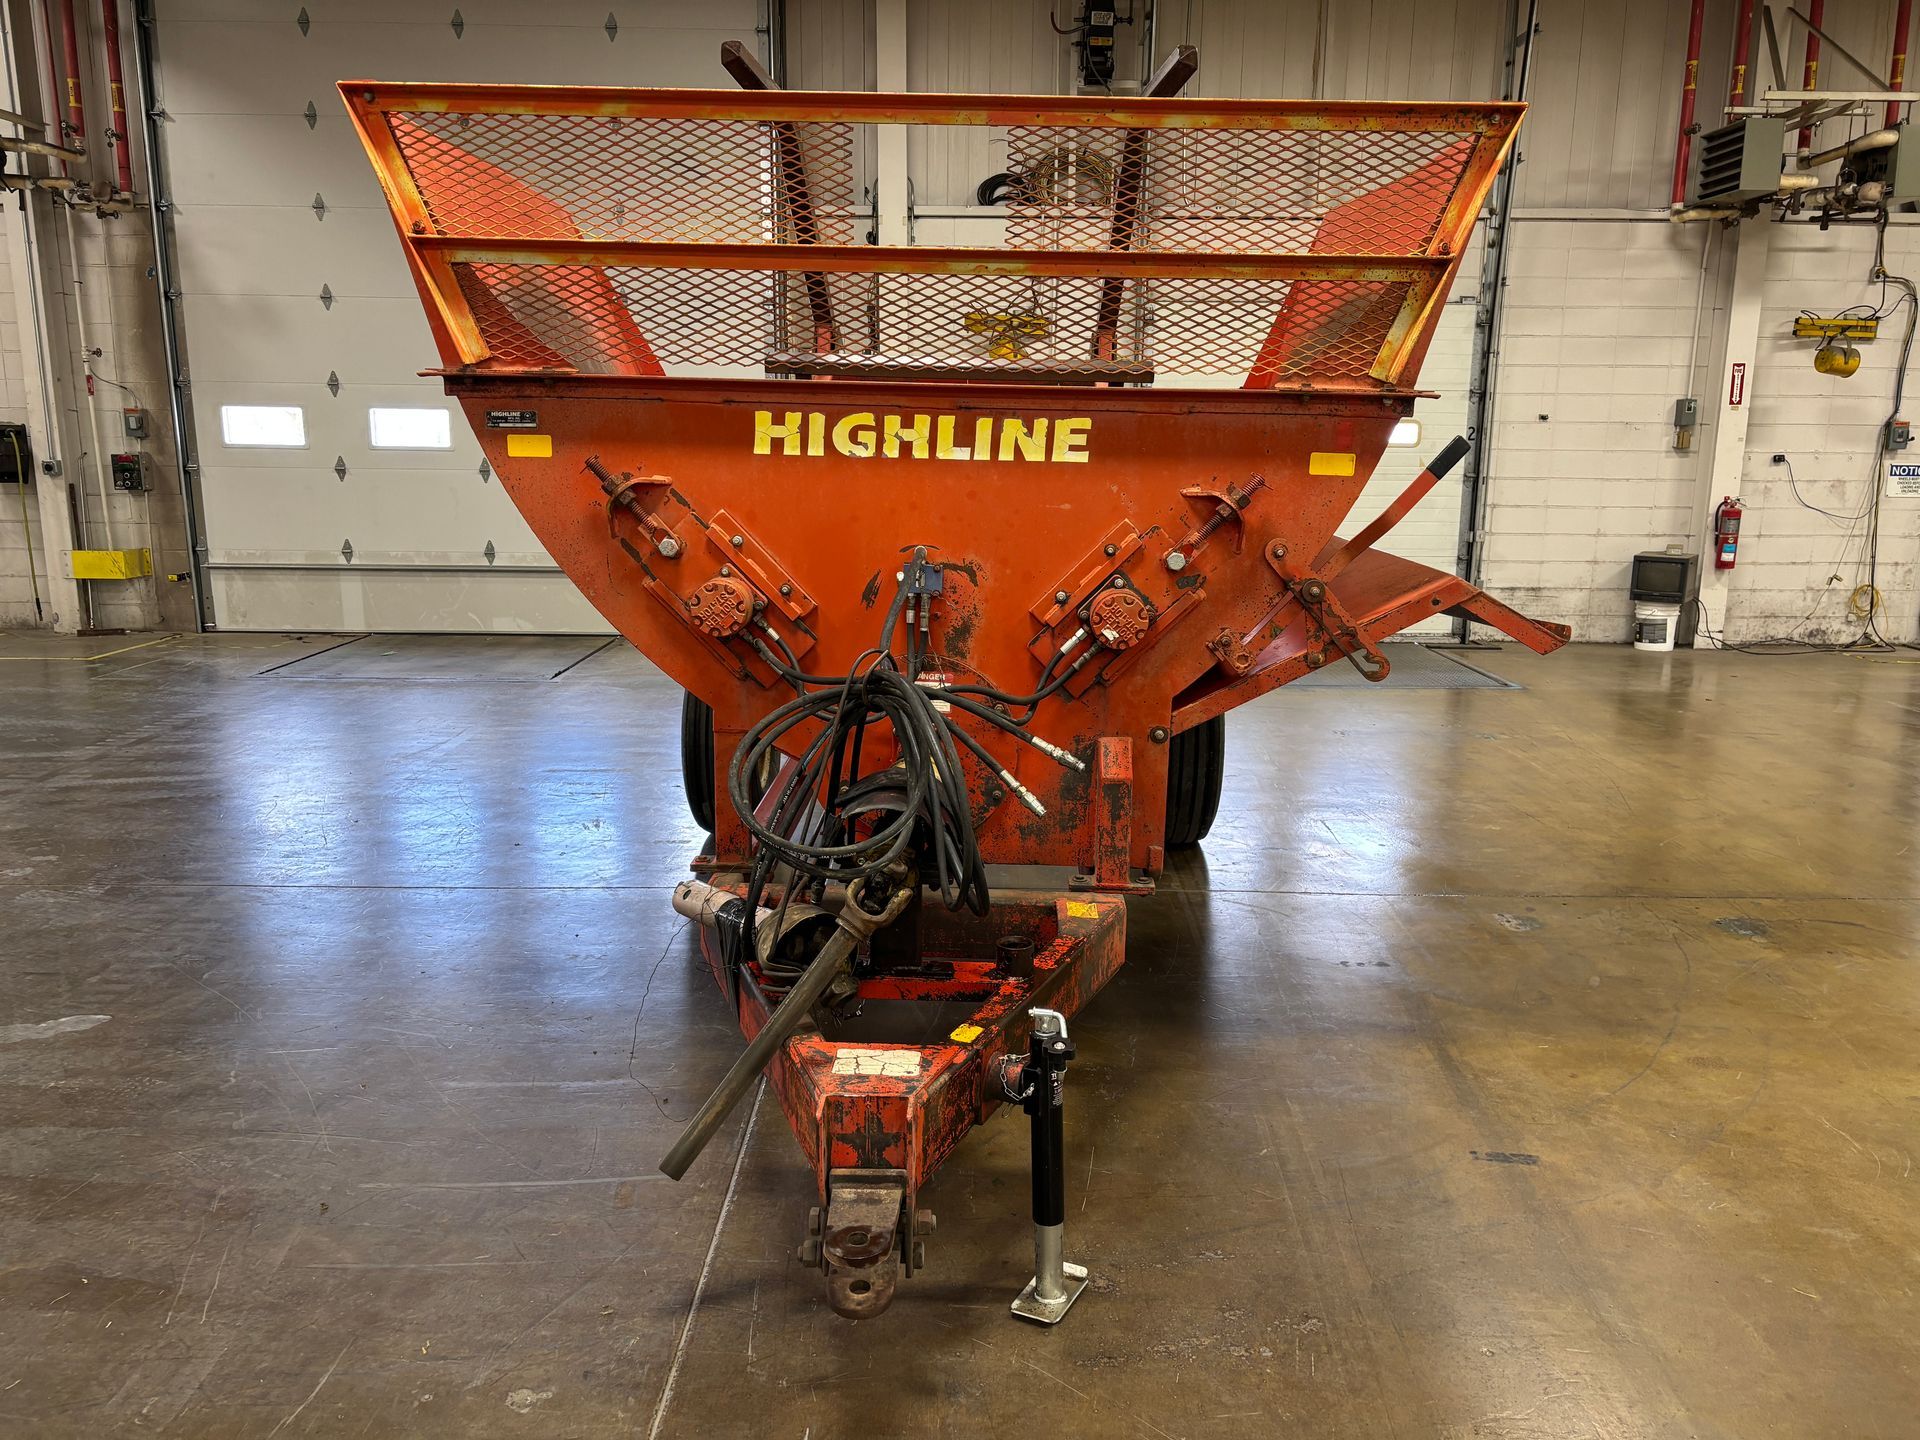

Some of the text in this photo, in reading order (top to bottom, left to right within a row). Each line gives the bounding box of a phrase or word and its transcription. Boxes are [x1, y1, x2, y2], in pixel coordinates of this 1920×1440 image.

[753, 411, 1092, 463] HIGHLINE
[1468, 426, 1475, 440] 2
[698, 592, 728, 620] STATOR
[706, 598, 737, 627] ROLLER
[1111, 603, 1139, 633] STATOR
[1102, 610, 1133, 641] ROLLER
[917, 672, 946, 680] ANGER
